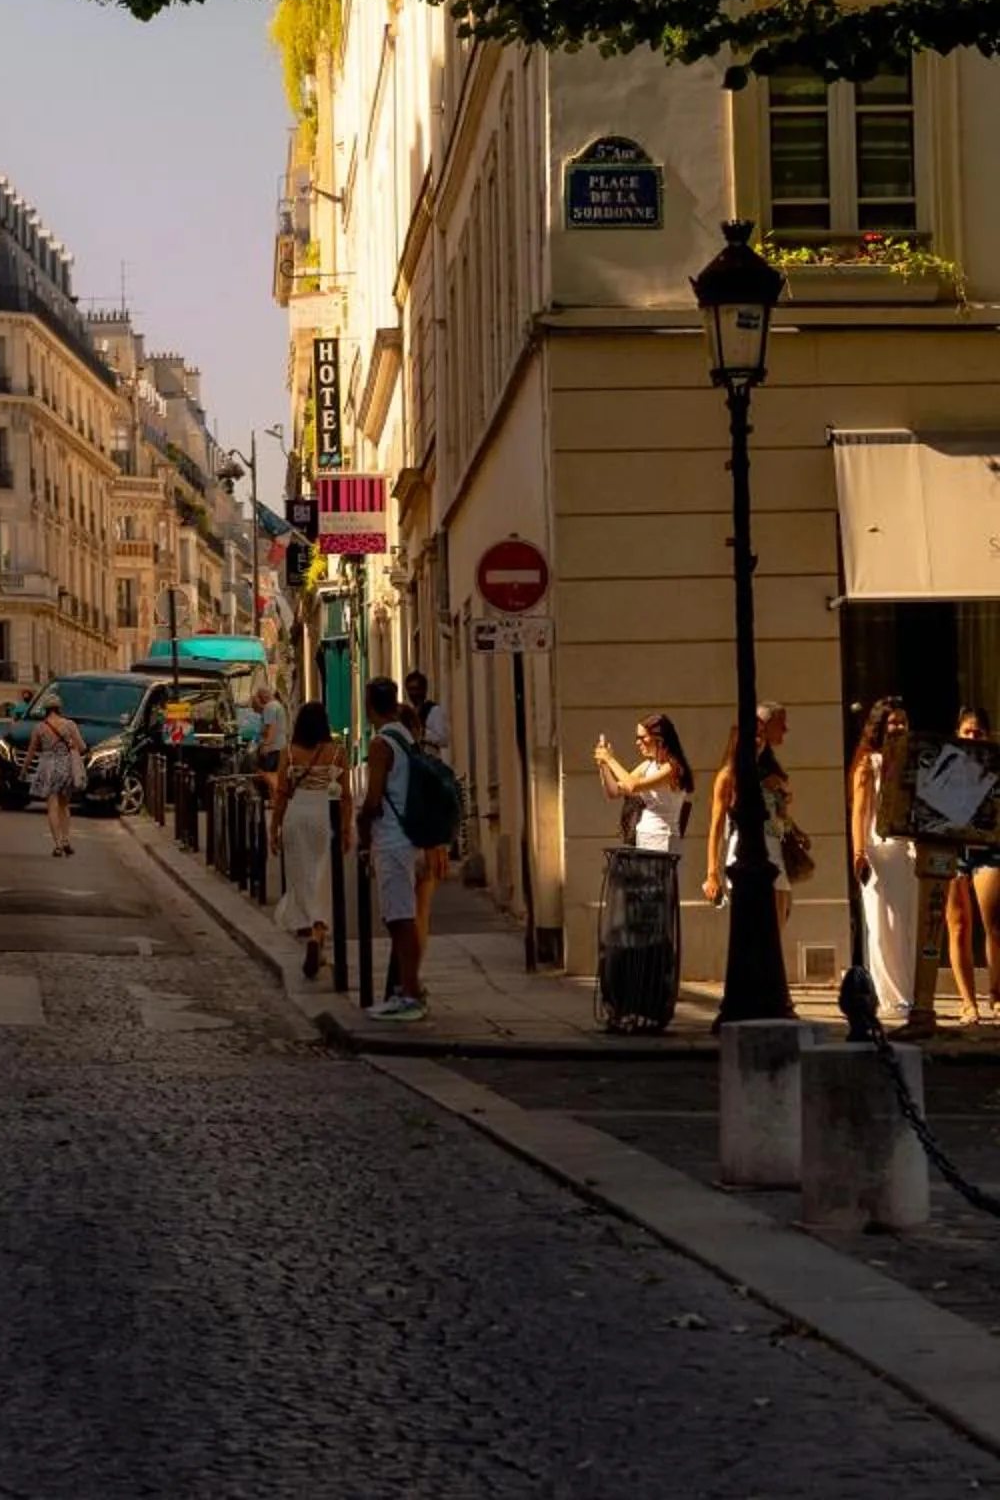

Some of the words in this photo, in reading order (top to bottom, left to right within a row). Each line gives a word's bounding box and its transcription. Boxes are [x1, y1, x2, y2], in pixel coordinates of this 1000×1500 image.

[588, 175, 639, 189] PLACE
[590, 190, 610, 203] DE
[616, 190, 636, 203] LA
[573, 206, 655, 219] SORBONNE
[318, 341, 338, 453] HOTEL
